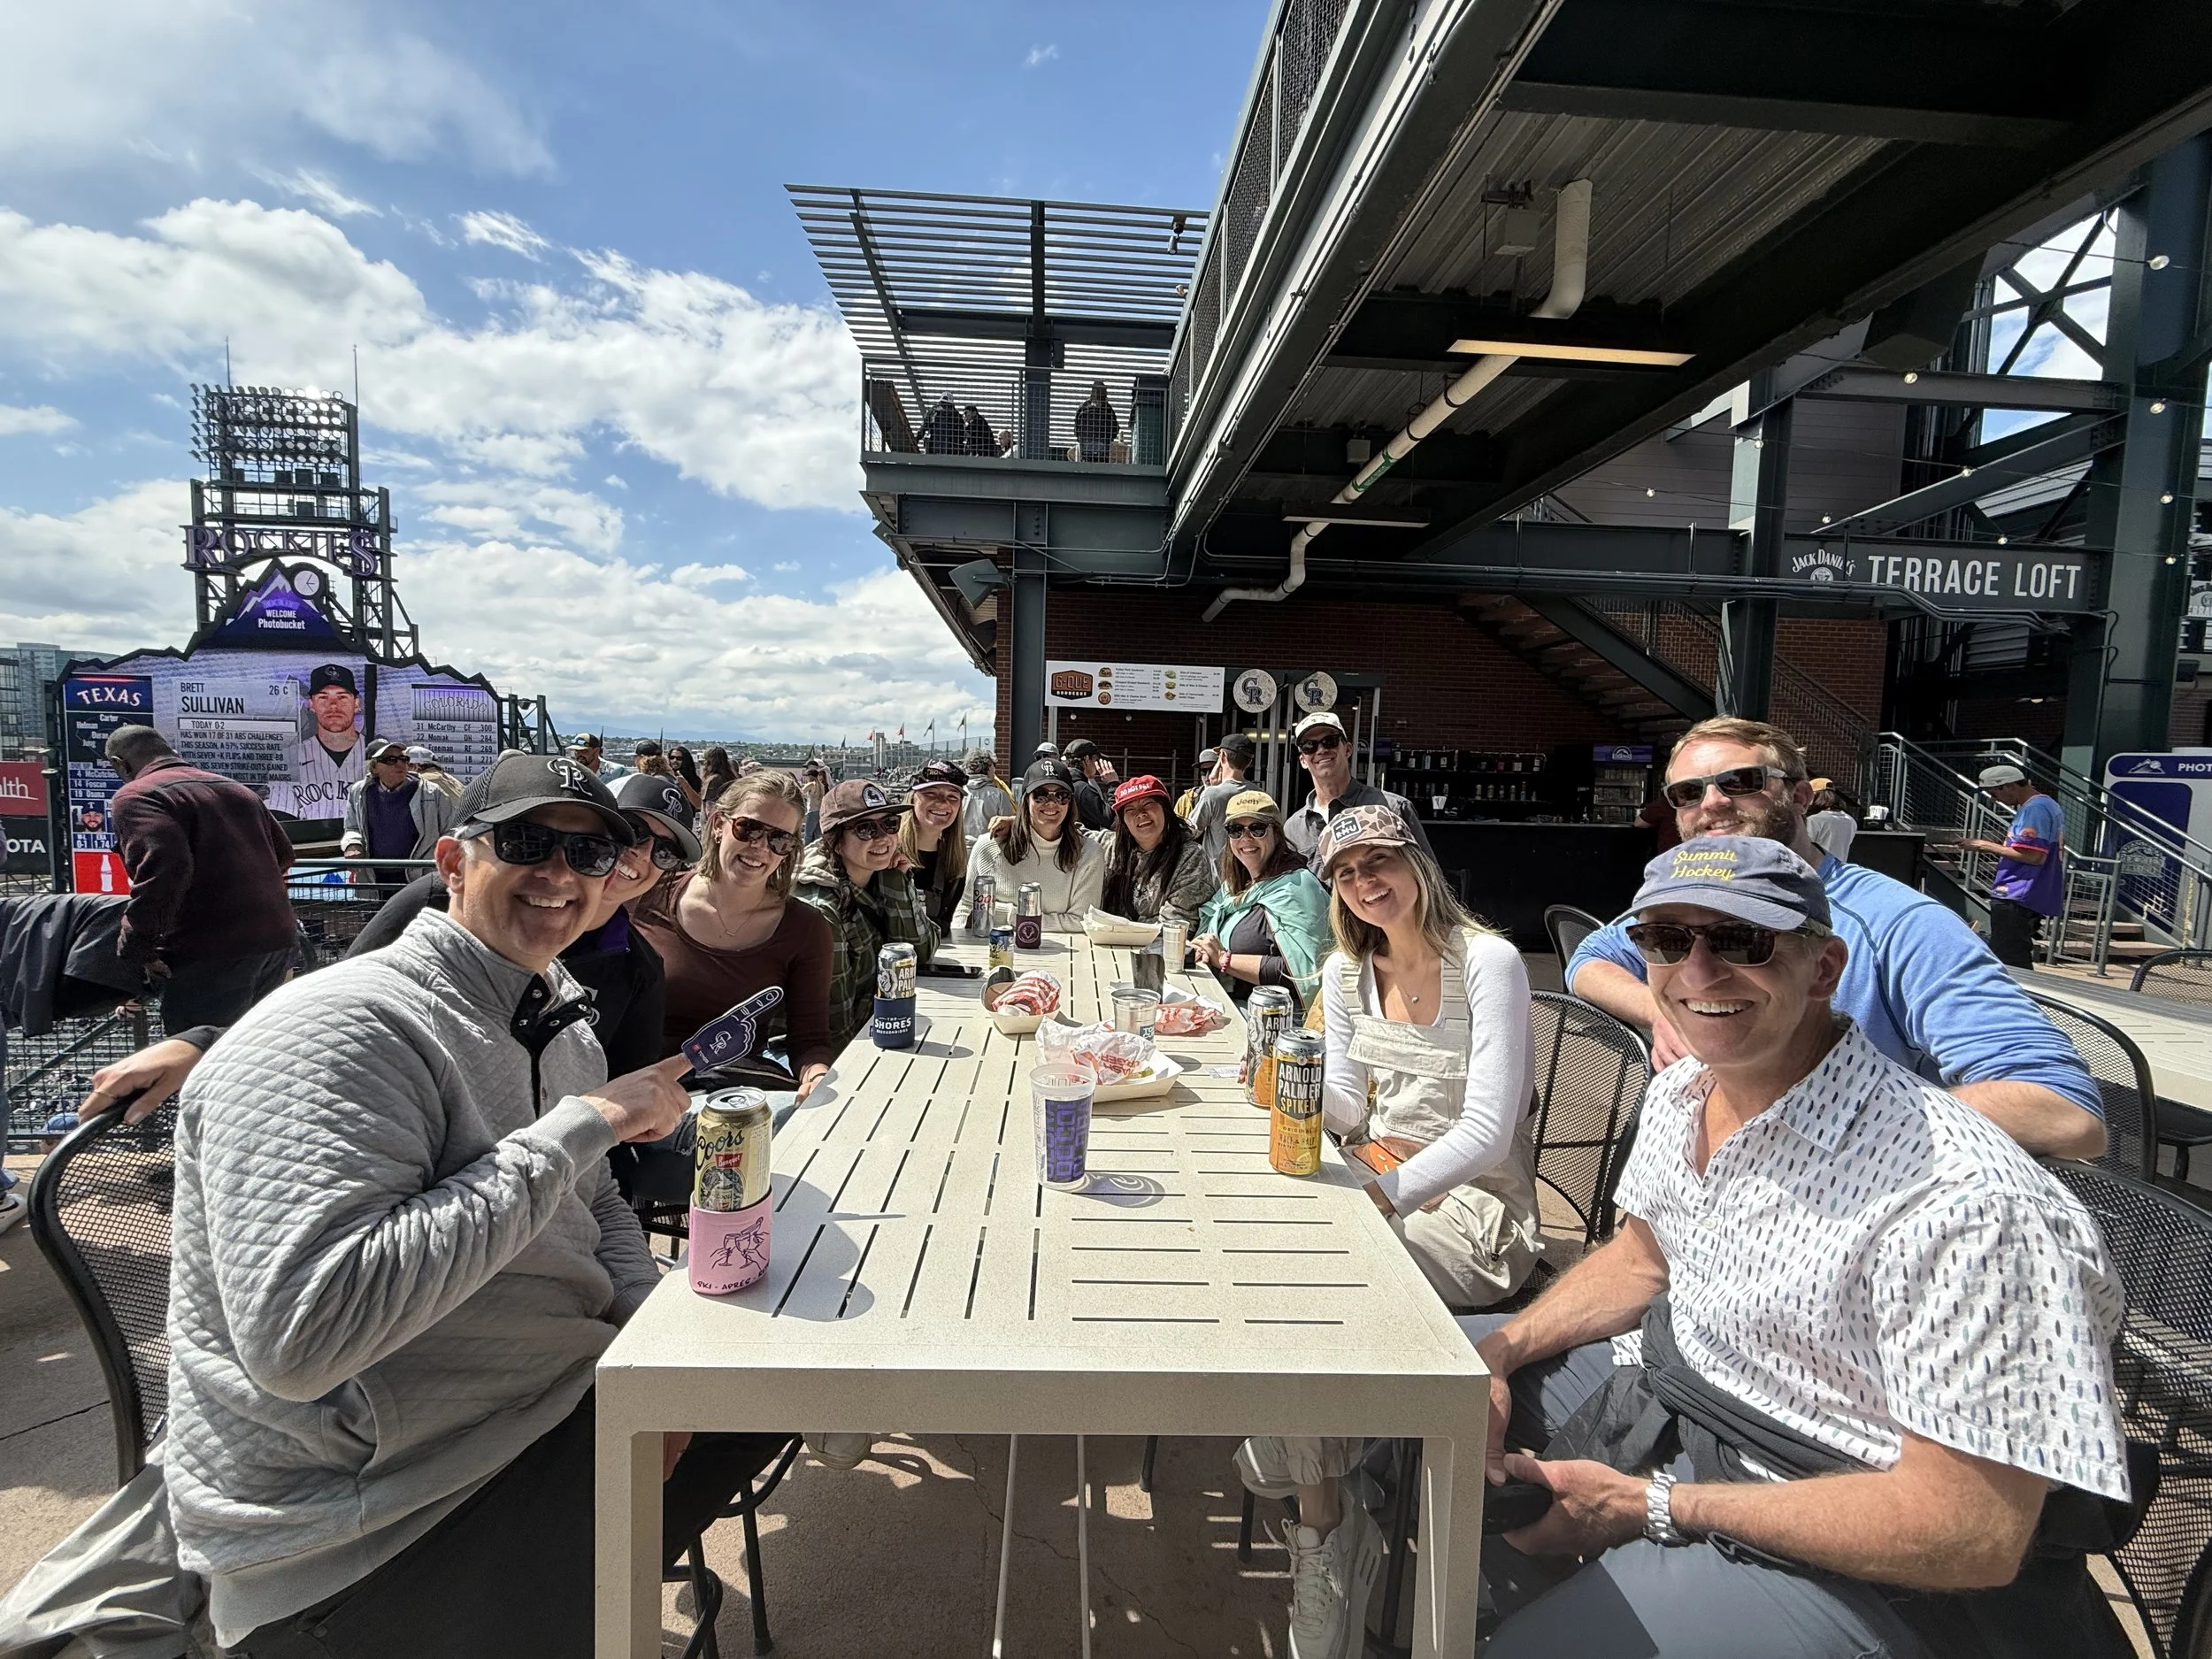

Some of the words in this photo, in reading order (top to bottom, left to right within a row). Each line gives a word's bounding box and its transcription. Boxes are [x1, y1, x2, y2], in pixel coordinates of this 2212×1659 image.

[179, 525, 379, 576] ROCKIES
[1792, 553, 1817, 573] JACK
[1867, 555, 2001, 596] TERRACE
[2013, 563, 2081, 599] LOFT
[265, 610, 296, 618] WELCOME
[257, 618, 306, 630] Photobucket
[180, 682, 204, 693] BRETT
[269, 685, 280, 695] 26
[283, 686, 288, 695] C
[1055, 675, 1089, 690] G-QUE
[76, 687, 142, 707] TEXAS
[181, 695, 245, 714] SULLIVAN
[423, 695, 488, 713] COLORADO
[191, 720, 213, 729] TODAY
[215, 721, 226, 730] 0-2
[427, 723, 456, 733] McCarthy
[416, 733, 425, 741] 22
[427, 743, 454, 752] Freeman
[0, 777, 29, 798] lth
[1673, 849, 1738, 865] Summit
[1670, 864, 1736, 881] Hockey
[874, 1017, 912, 1030] SHORES
[1279, 1063, 1322, 1083] ARNOLD
[1278, 1079, 1321, 1100] PALMER
[1280, 1096, 1317, 1114] SPIKED
[696, 1129, 745, 1171] Coors
[697, 1279, 712, 1290] SKI
